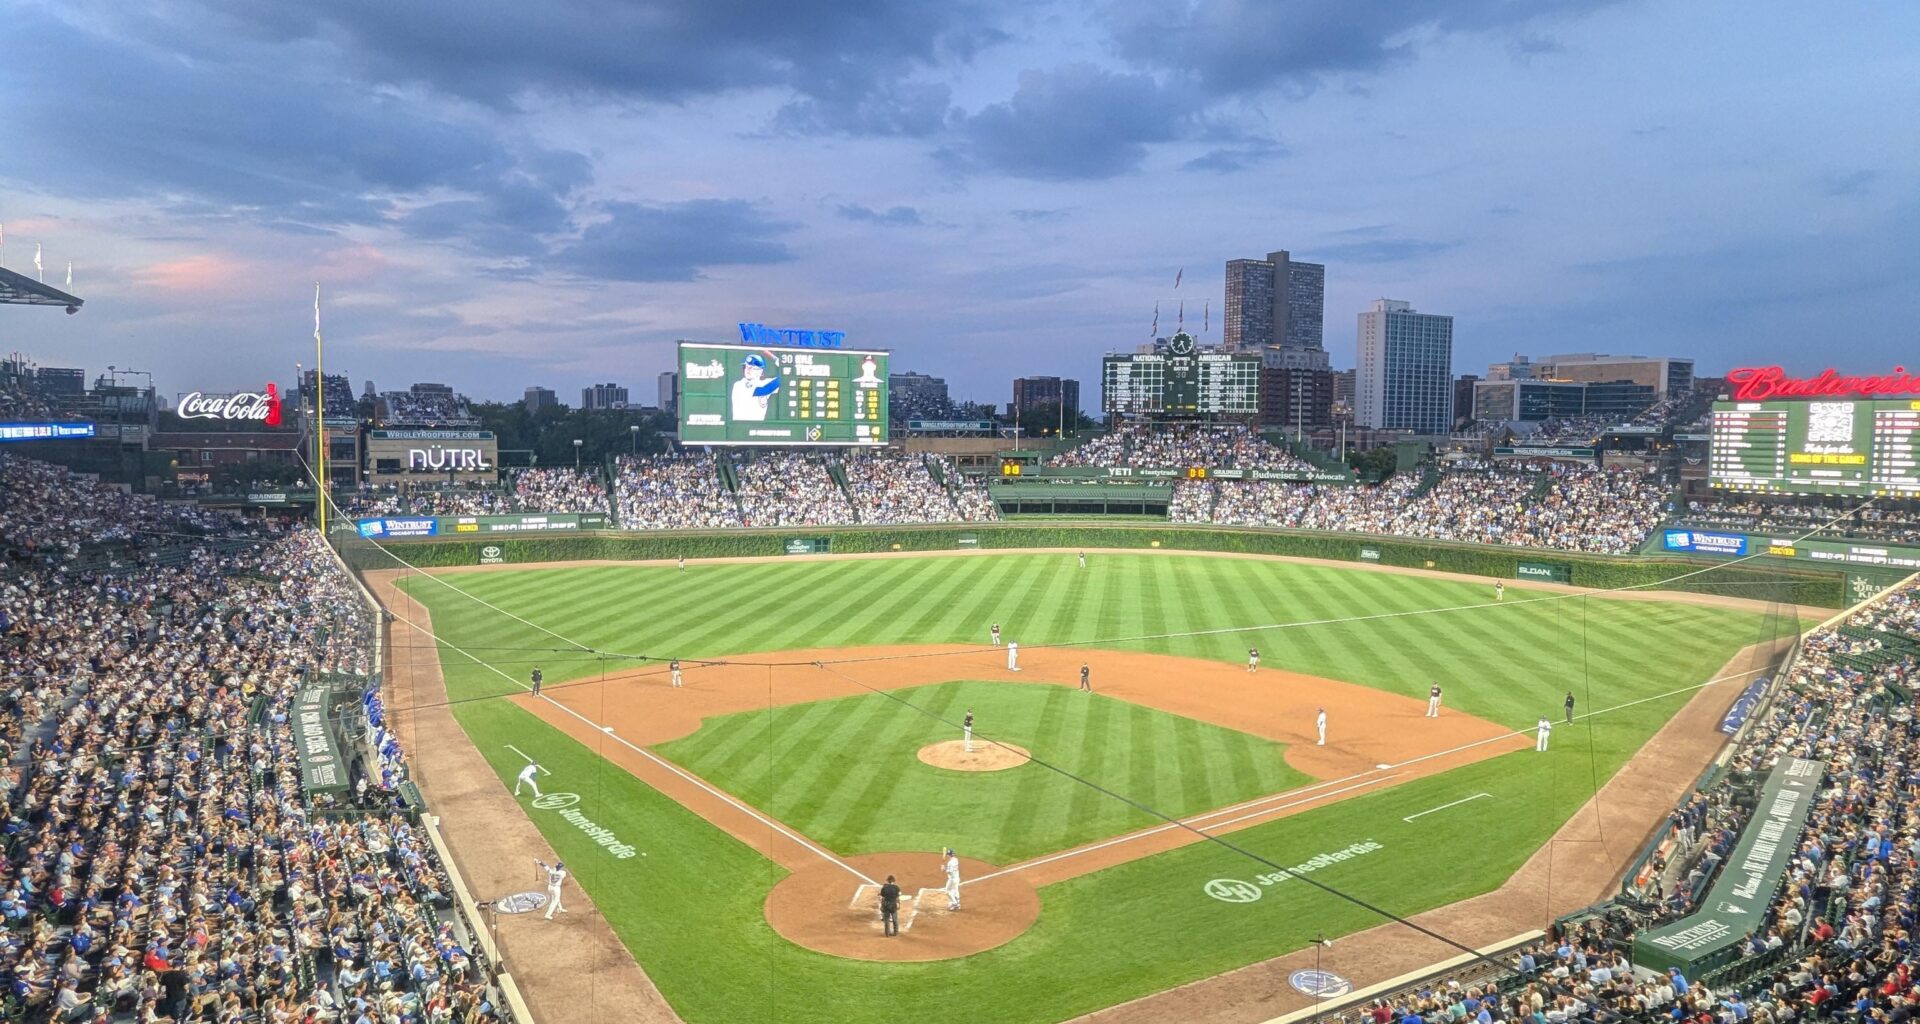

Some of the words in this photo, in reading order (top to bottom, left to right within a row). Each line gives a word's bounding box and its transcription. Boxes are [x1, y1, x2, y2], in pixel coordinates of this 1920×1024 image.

[782, 354, 793, 364] 30
[178, 391, 272, 420] Coca-Cola
[1108, 467, 1132, 476] YETI
[1252, 470, 1297, 479] Budweiser
[385, 520, 434, 530] WINTRUST
[1692, 533, 1745, 547] WINTRUST
[1255, 838, 1384, 886] JamesHardie
[1652, 919, 1725, 947] WINTRUST
